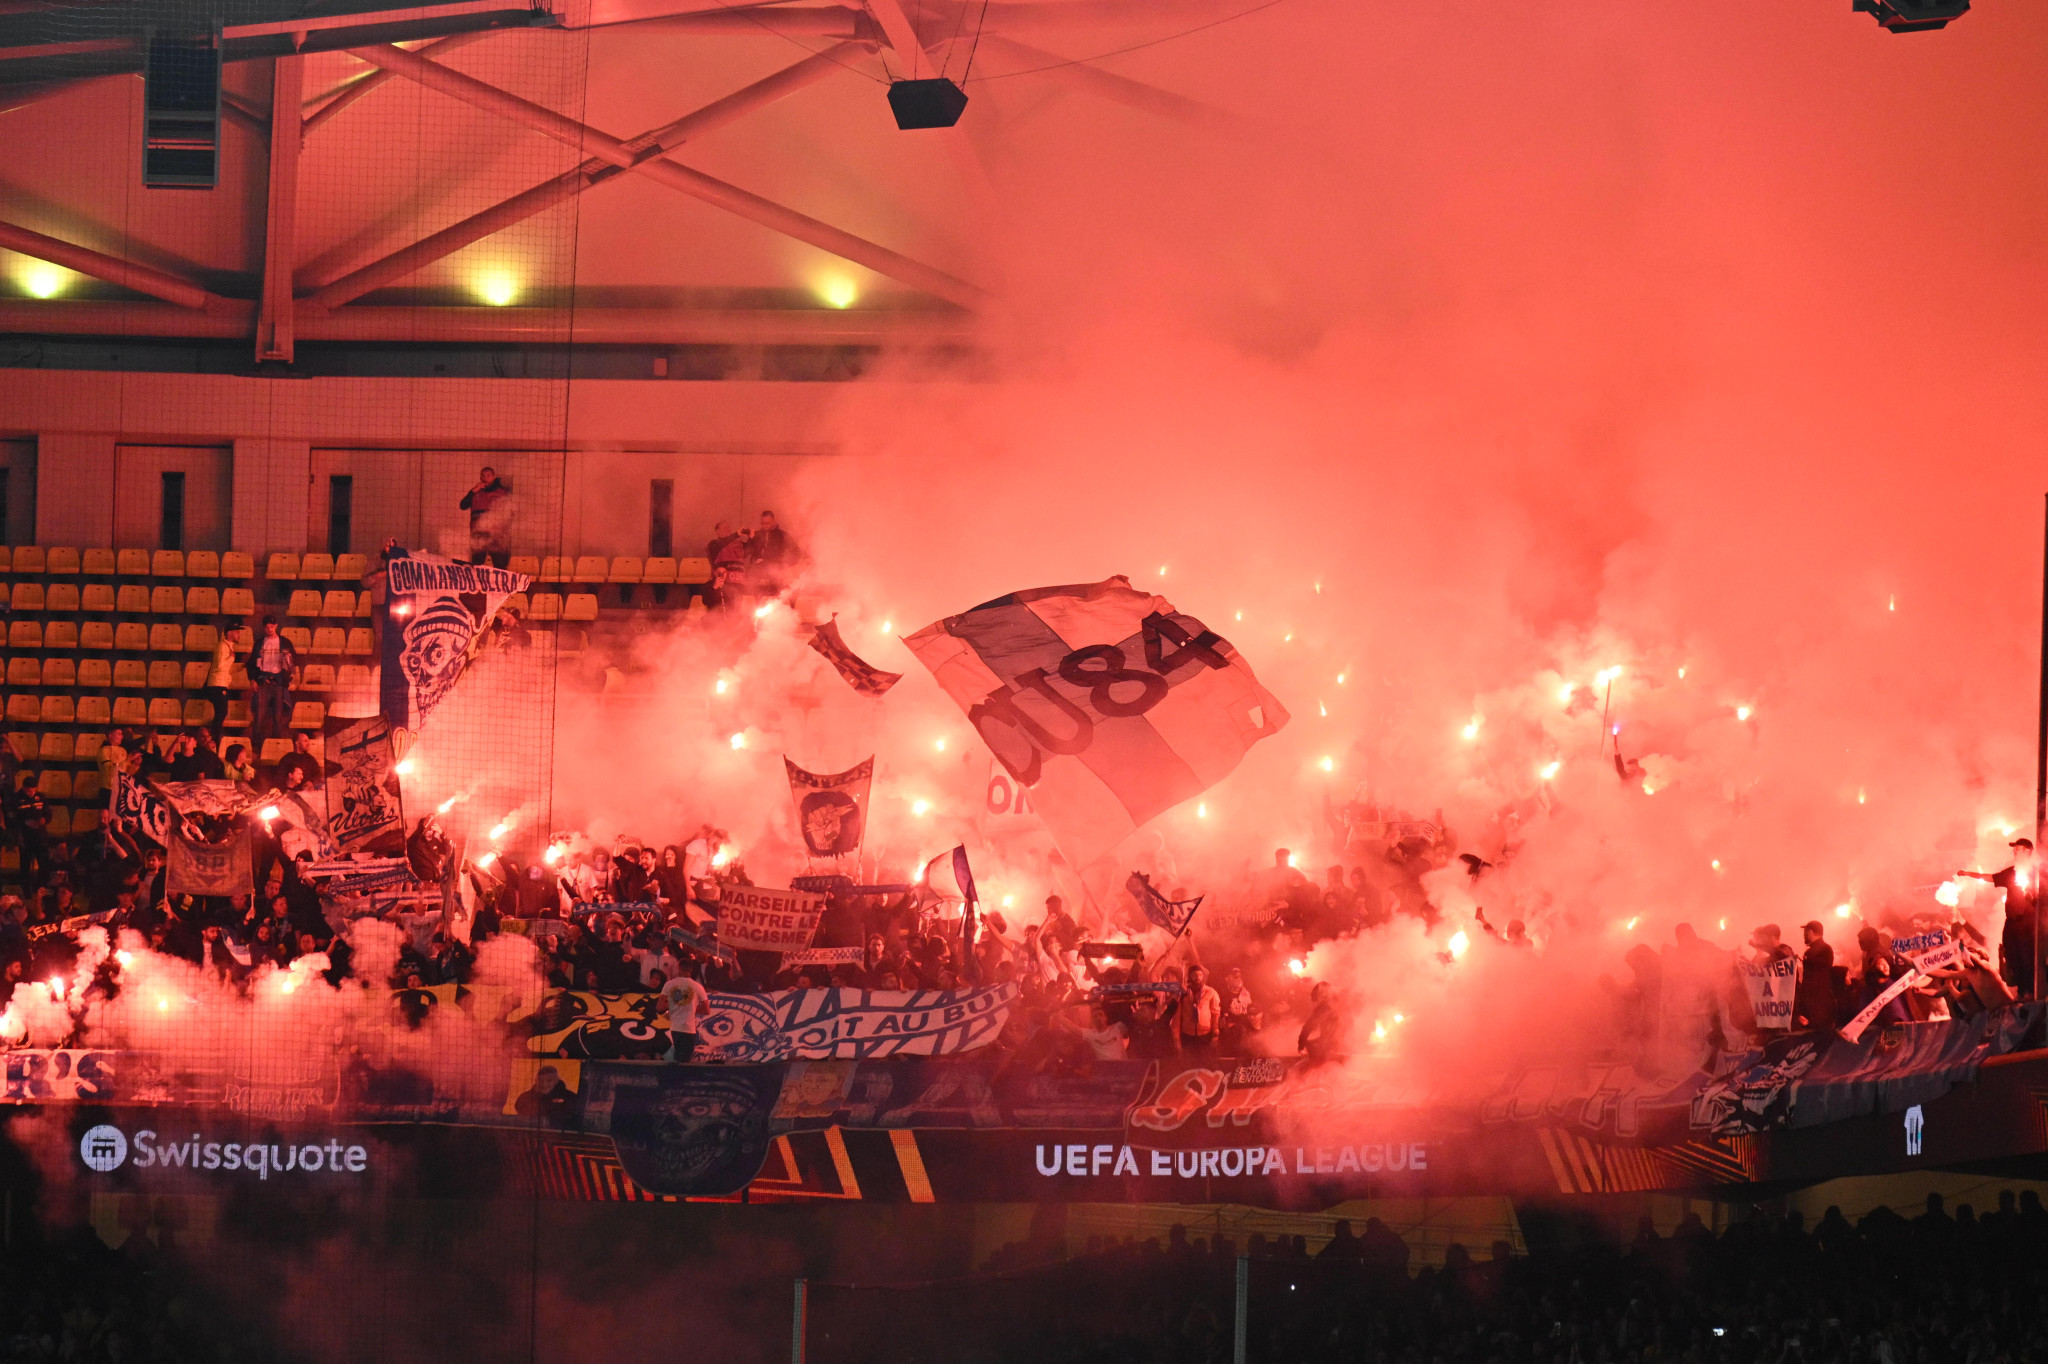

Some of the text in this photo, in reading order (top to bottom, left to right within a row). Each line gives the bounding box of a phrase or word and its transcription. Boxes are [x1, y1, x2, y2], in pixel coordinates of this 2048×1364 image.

[391, 561, 476, 592] COMMANDO
[968, 611, 1230, 788] CU84
[720, 887, 823, 914] MARSEILLE
[720, 905, 818, 930] CONTRE LE
[724, 922, 808, 945] RACISME
[872, 1012, 929, 1035] AU
[943, 984, 1017, 1025] BUT
[133, 1130, 367, 1180] Swissquote
[1035, 1142, 1428, 1178] UEFA EUROPA LEAGUE
